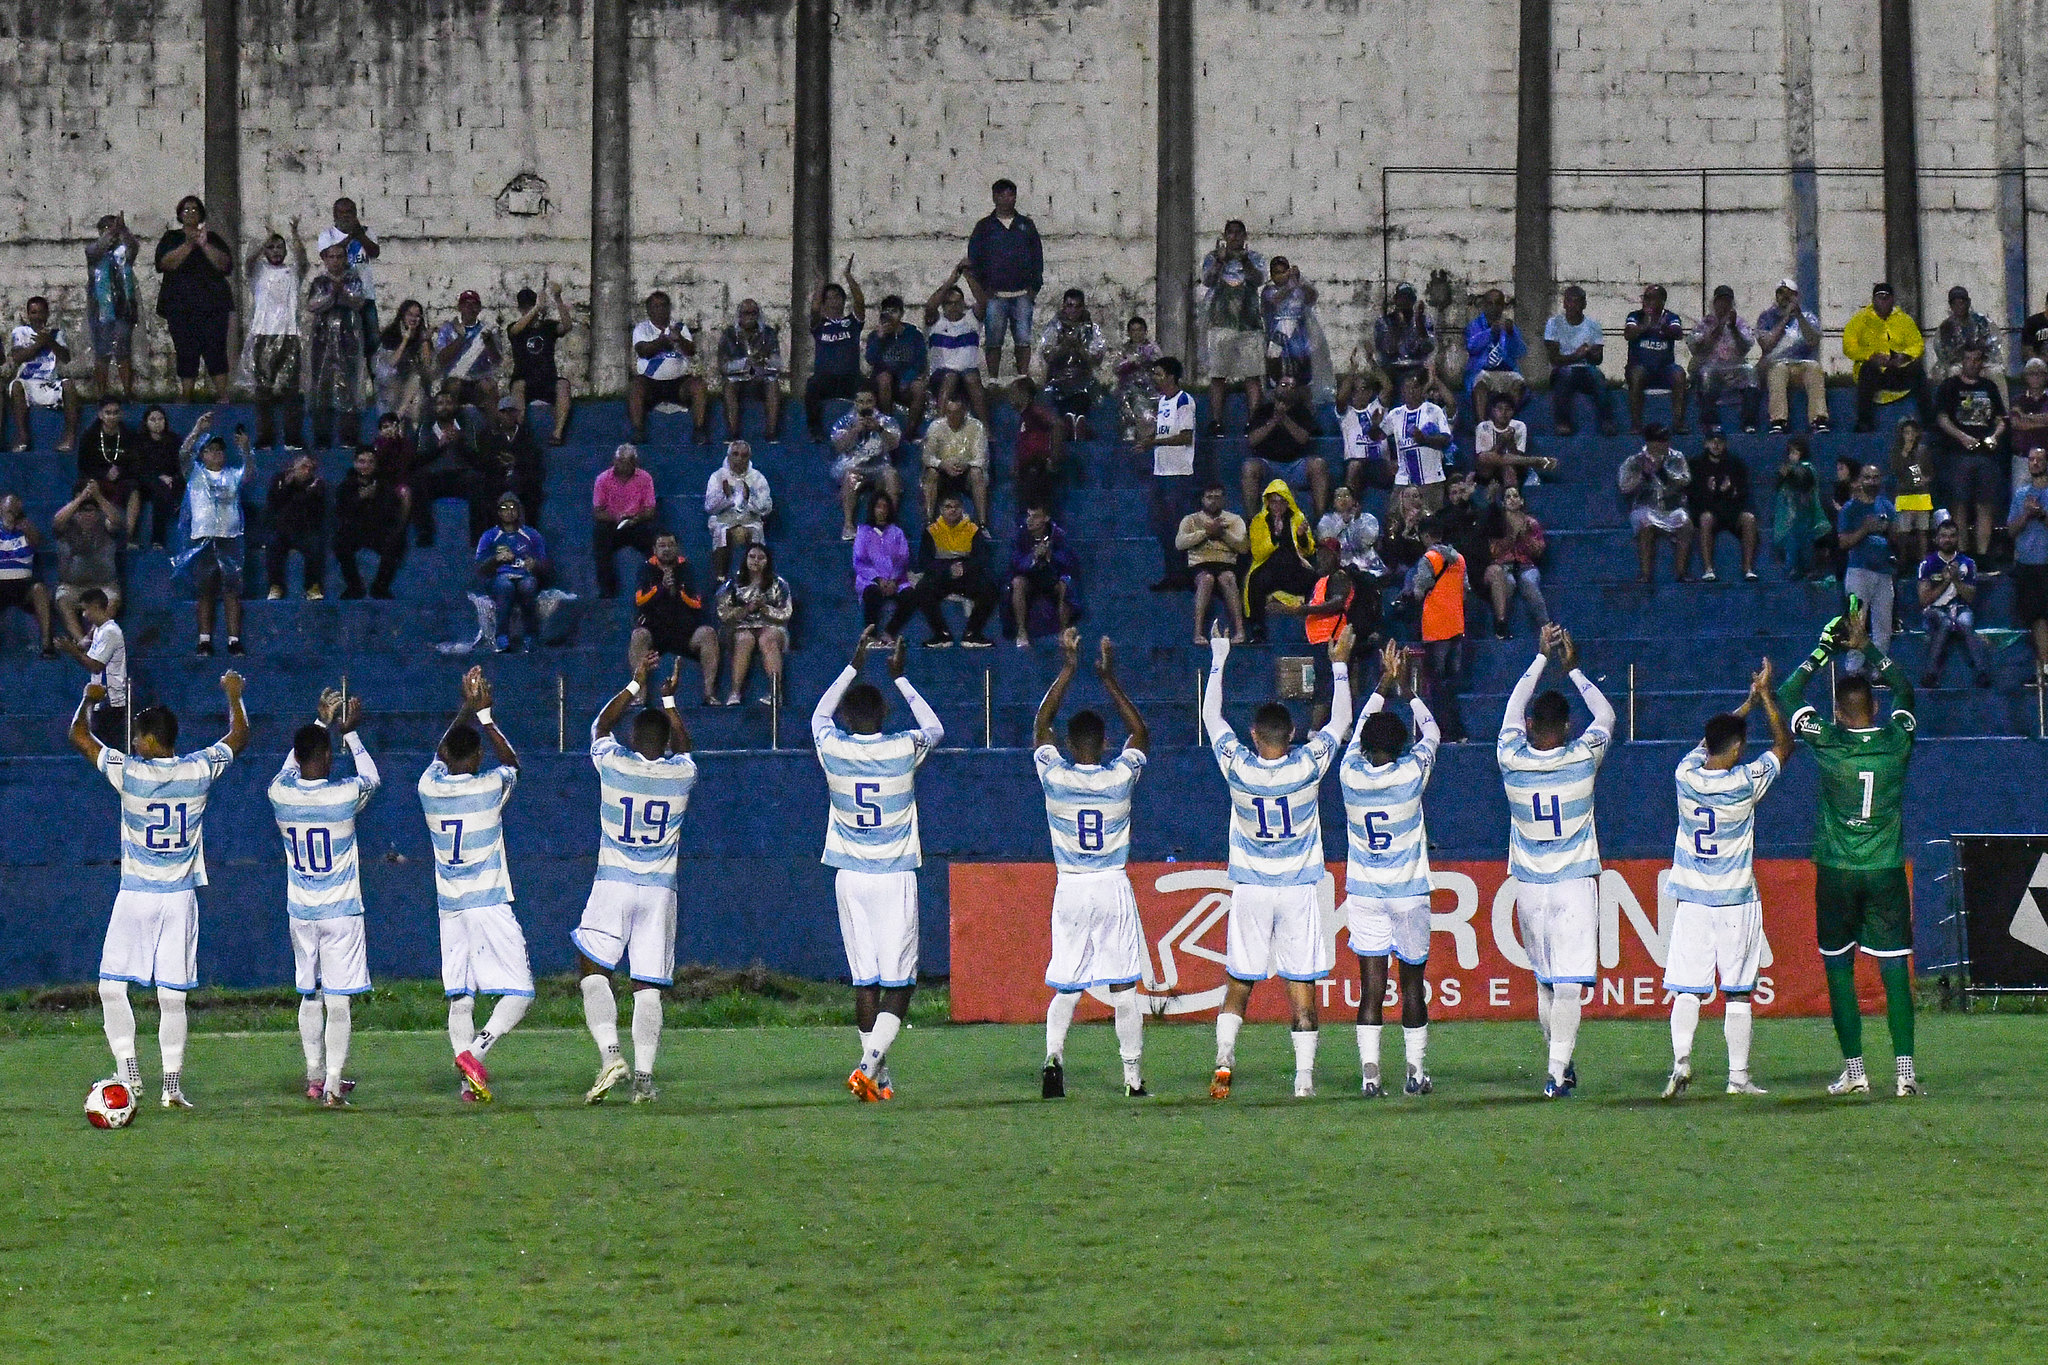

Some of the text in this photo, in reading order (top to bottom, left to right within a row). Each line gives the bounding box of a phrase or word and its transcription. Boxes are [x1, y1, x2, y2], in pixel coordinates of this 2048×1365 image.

[854, 782, 882, 827] 5
[1251, 796, 1297, 839] 11
[1532, 792, 1562, 837] 4
[1858, 771, 1874, 819] 1
[146, 803, 190, 849] 21
[441, 819, 463, 865] 7
[617, 796, 671, 845] 19
[1077, 809, 1104, 851] 8
[1364, 811, 1393, 850] 6
[1693, 806, 1718, 855] 2
[286, 827, 333, 873] 10
[1316, 868, 1774, 971] KRN
[1489, 978, 1511, 1006] E
